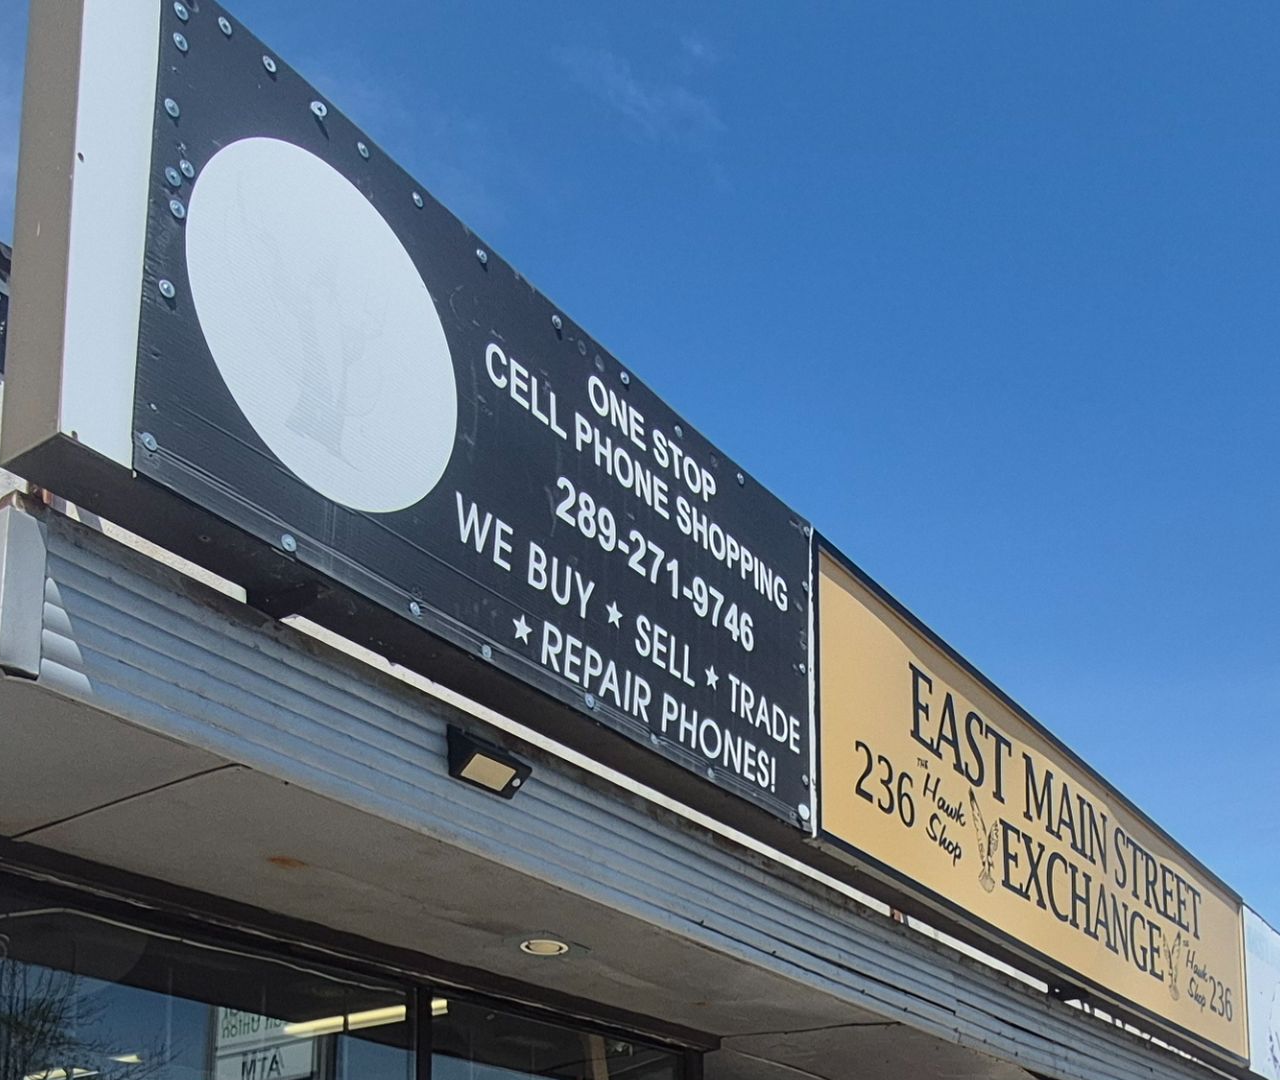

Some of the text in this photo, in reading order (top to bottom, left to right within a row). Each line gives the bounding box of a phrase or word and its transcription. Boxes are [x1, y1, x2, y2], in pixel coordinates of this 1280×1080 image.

[485, 343, 788, 612] CELL PHONE SHOPPING
[587, 375, 716, 502] ONE STOP
[455, 491, 801, 755] WE BUY SELL TRADE
[555, 476, 754, 652] 289-271-9746
[541, 620, 777, 793] REPAIR PHONES!
[854, 740, 915, 828] 236
[909, 662, 1201, 940] EAST MAIN STREET
[923, 771, 966, 828] Hawk
[925, 812, 962, 867] Shop
[998, 817, 1165, 982] EXCHANGE
[1187, 975, 1207, 1012] Shop
[1208, 975, 1234, 1022] 236
